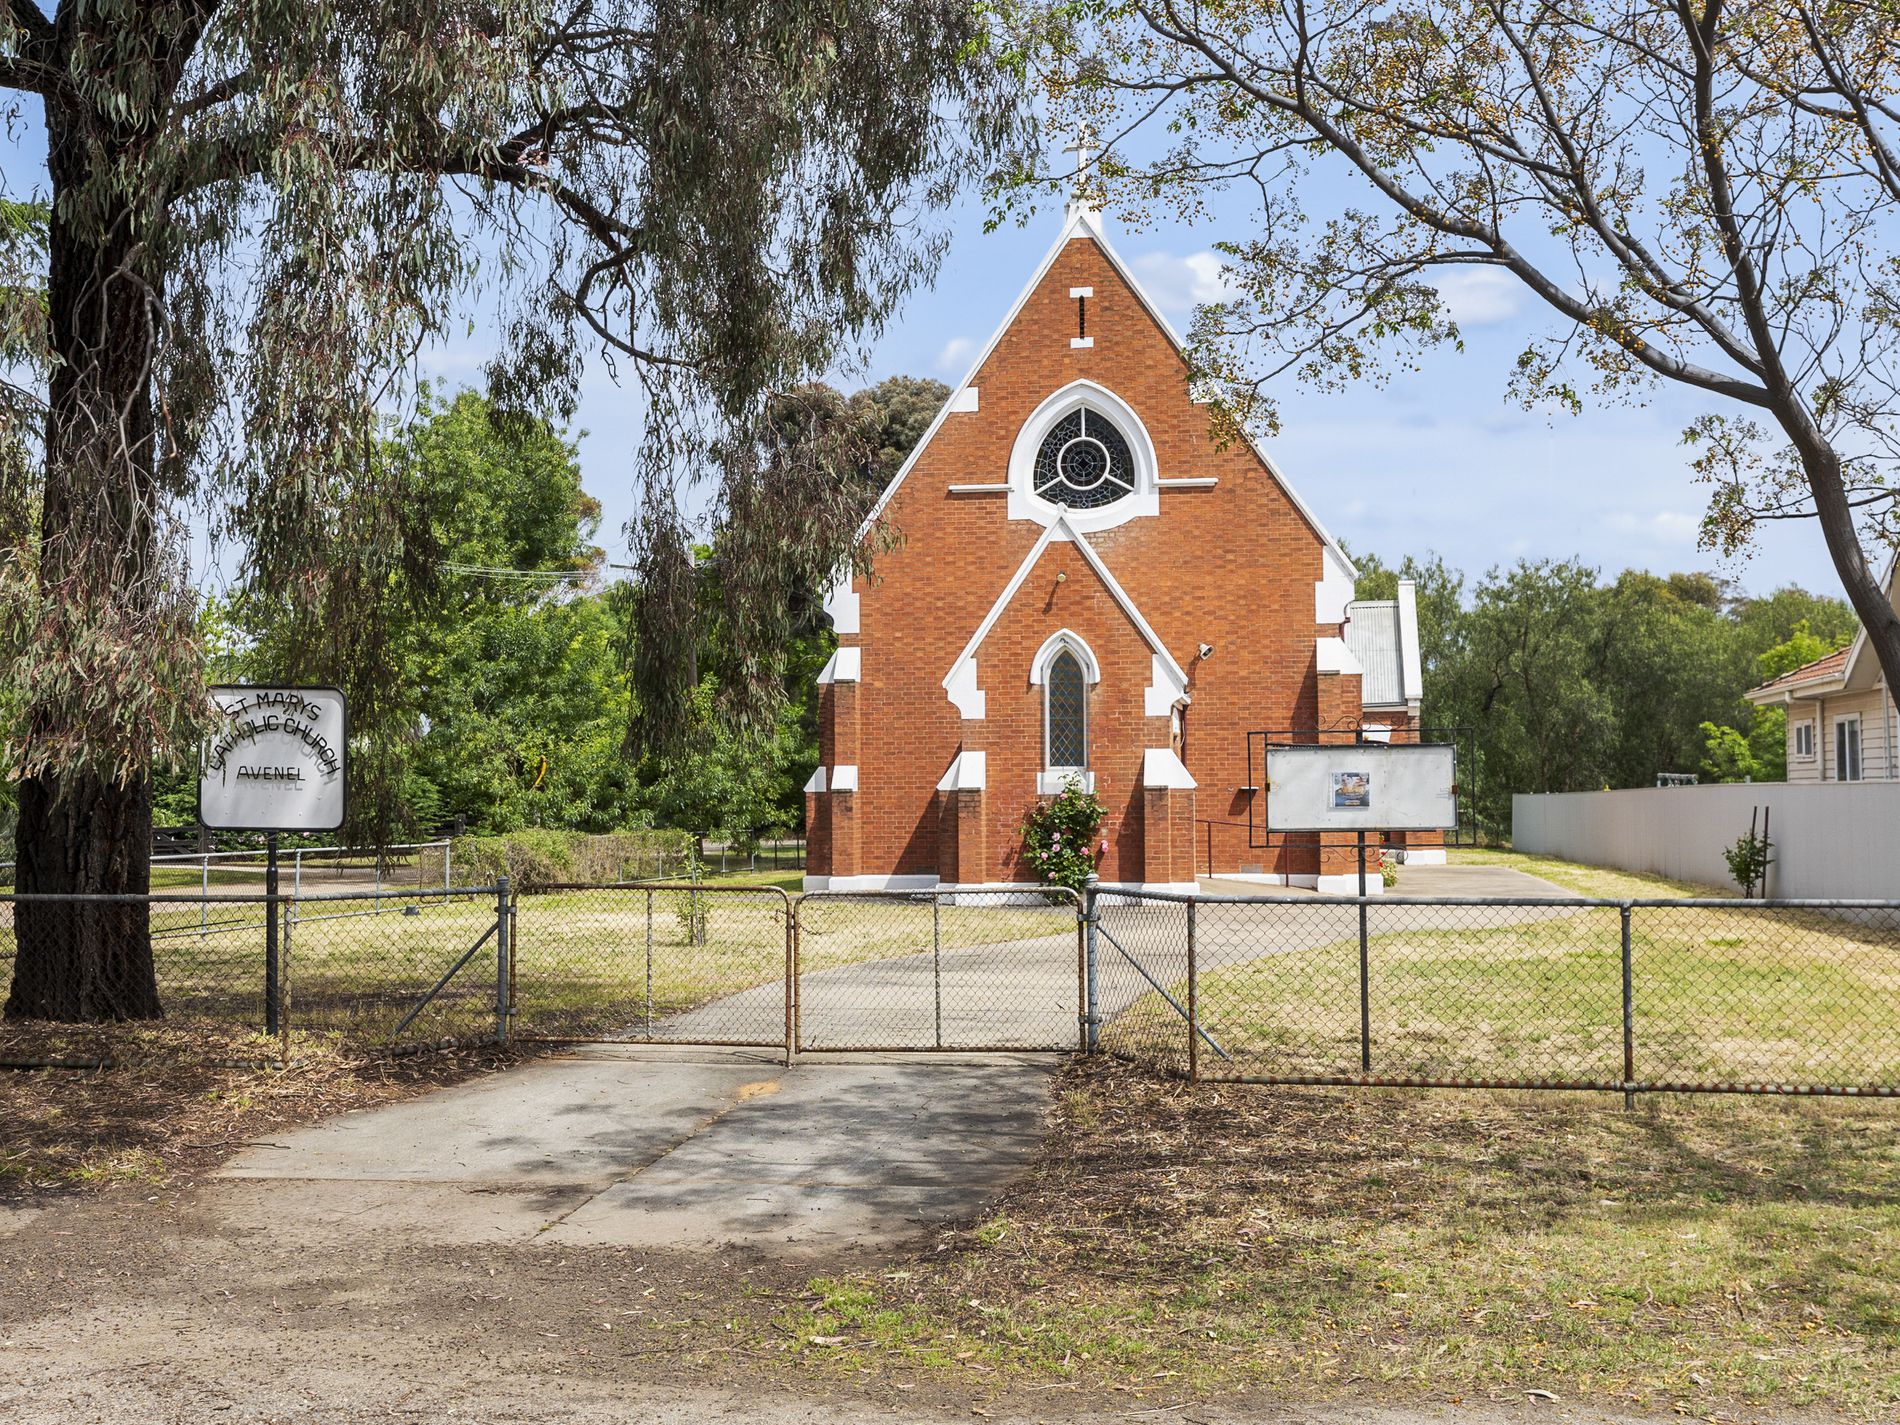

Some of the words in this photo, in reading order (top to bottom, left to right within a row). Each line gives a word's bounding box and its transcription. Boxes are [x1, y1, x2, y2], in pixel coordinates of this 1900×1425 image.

[225, 697, 247, 720] ST
[256, 692, 322, 721] MARYS
[283, 717, 341, 776] CHURCH
[236, 765, 306, 782] AVENEL
